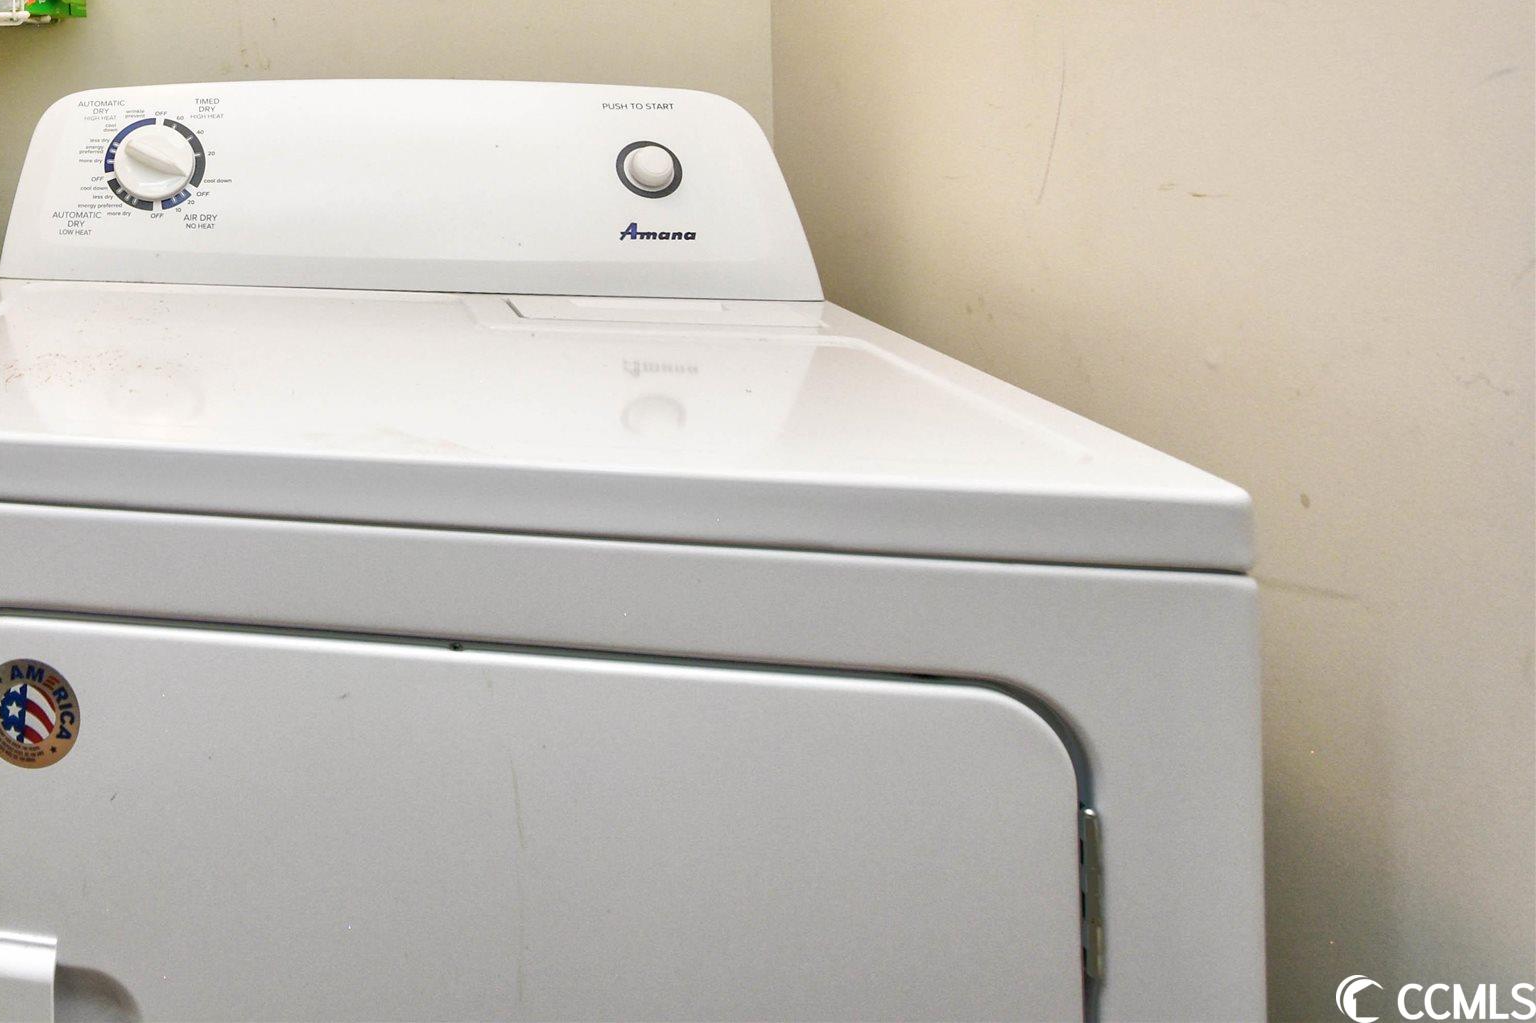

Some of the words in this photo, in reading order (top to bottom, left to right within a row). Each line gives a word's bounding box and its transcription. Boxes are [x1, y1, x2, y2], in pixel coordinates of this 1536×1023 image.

[52, 211, 103, 219] AUTOMATIC
[199, 214, 218, 222] DRY
[67, 220, 85, 228] DRY
[619, 222, 697, 241] Amana
[10, 665, 75, 739] AMERICA
